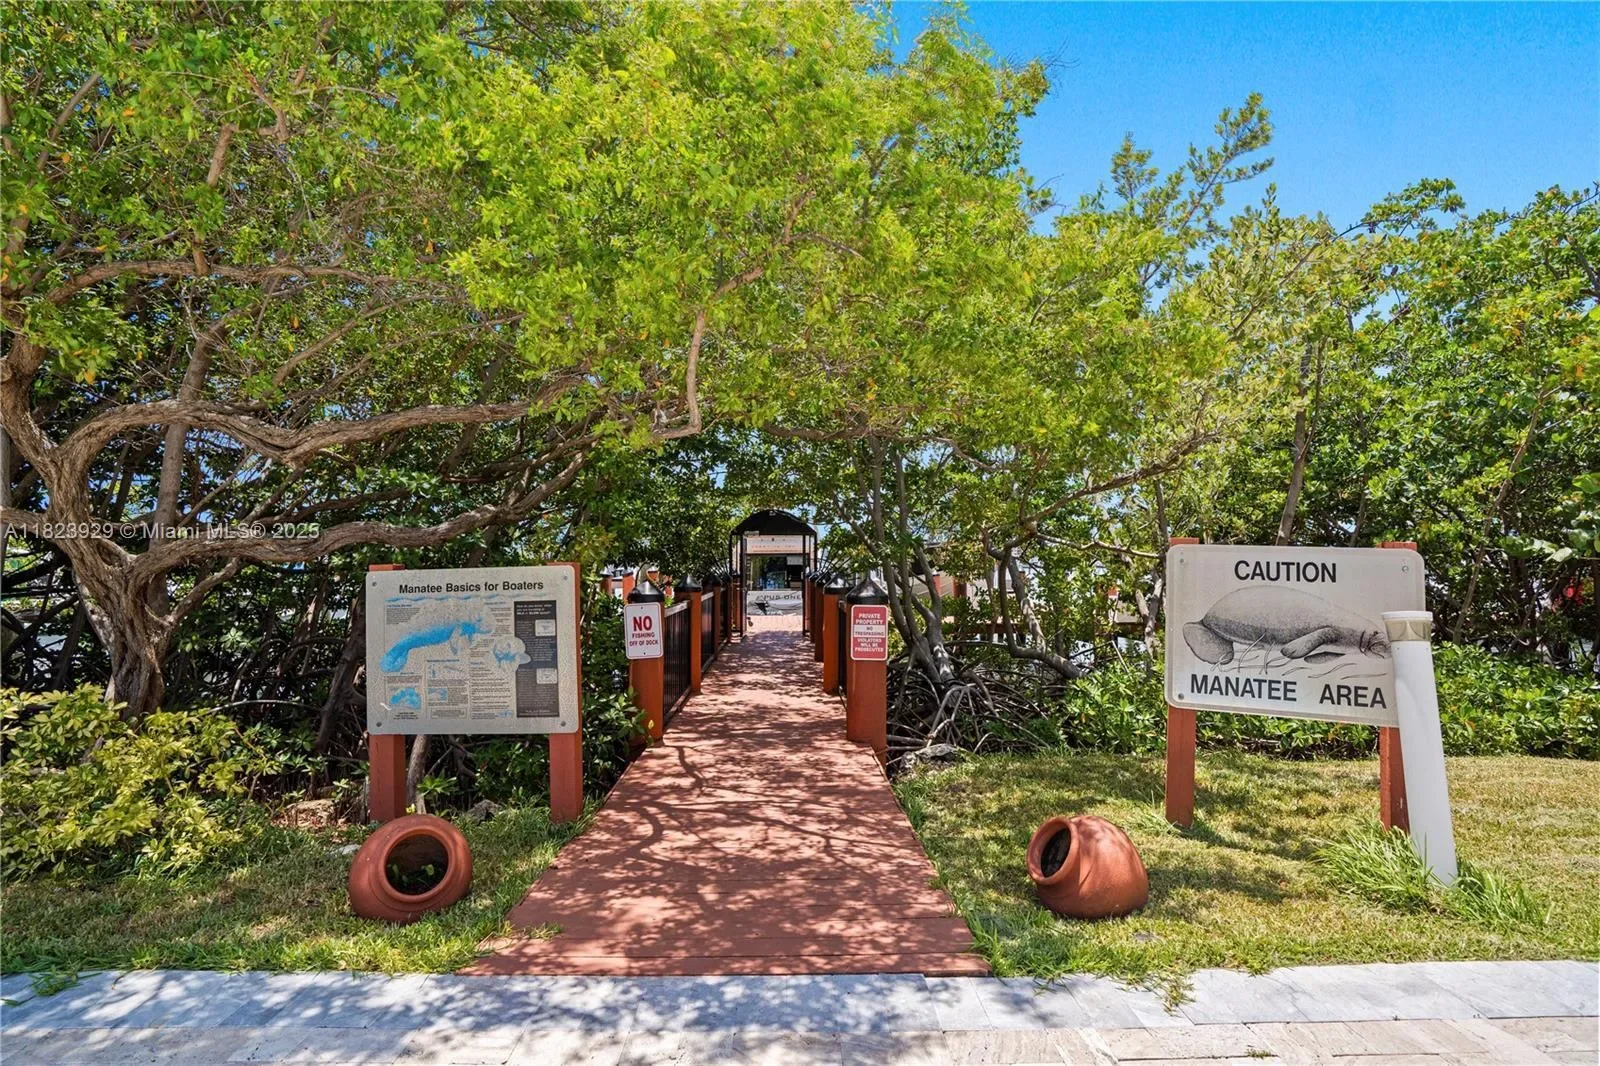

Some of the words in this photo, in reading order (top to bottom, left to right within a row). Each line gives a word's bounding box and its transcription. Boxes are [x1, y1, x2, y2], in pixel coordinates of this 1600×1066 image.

[1234, 560, 1337, 583] CAUTION
[399, 583, 442, 594] Manatee
[446, 582, 481, 593] Basics
[484, 581, 498, 592] for
[502, 581, 544, 591] Boaters
[633, 615, 652, 631] NO
[1190, 673, 1297, 702] MANATEE
[1319, 683, 1387, 709] AREA
